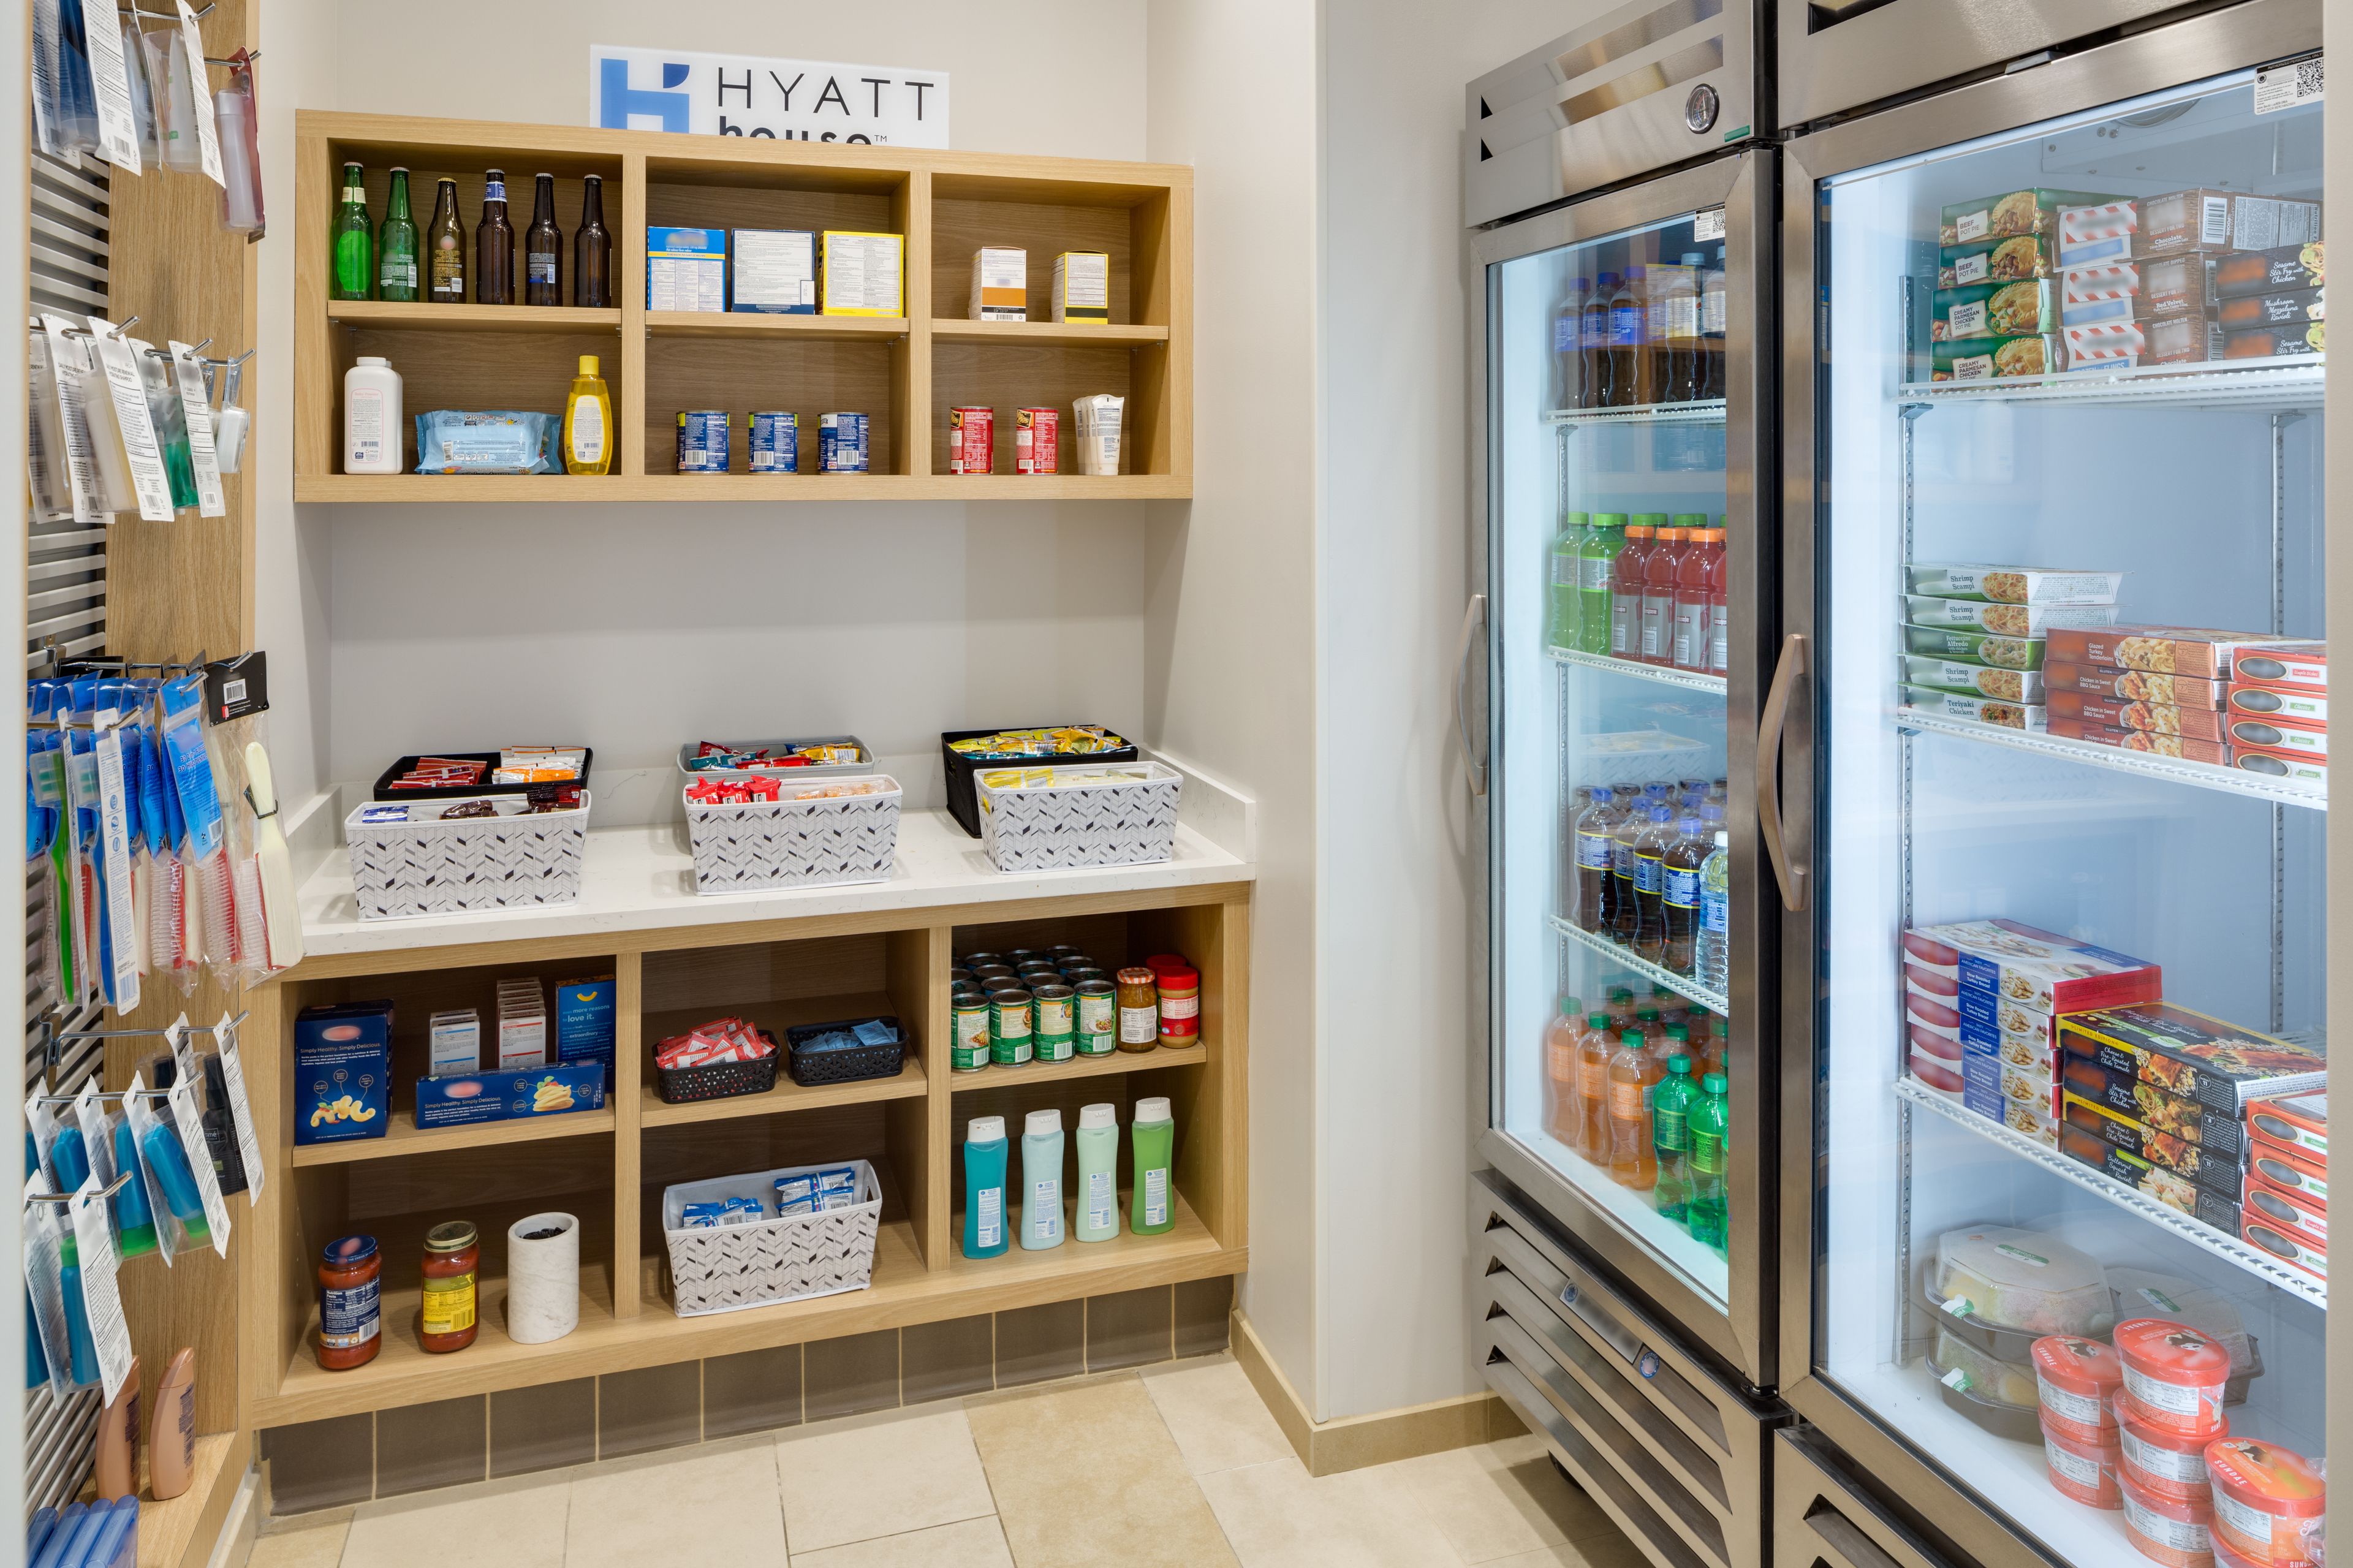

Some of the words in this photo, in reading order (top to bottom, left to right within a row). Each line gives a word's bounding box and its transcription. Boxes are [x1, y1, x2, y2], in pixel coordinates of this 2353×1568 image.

[719, 67, 934, 121] HYATT
[2147, 197, 2167, 206] CHOCOLATE
[1960, 220, 1974, 229] BEEF
[2155, 235, 2181, 244] Chocolate
[1958, 262, 1972, 271] BEEF
[2272, 275, 2296, 284] Chicken
[2265, 298, 2294, 307] Mushroom
[1954, 306, 1972, 316] CREAMY
[1954, 310, 1979, 320] PARMESAN
[2268, 305, 2298, 314] Mezzaluna
[1955, 316, 1974, 325] CHICKEN
[2153, 320, 2173, 328] CHOCOLATE
[1959, 364, 1986, 373] PARMESAN
[1961, 960, 1978, 968] AMERICAN
[1979, 965, 1995, 974] FAVORITES
[1976, 975, 1990, 983] Roasted
[1961, 990, 1977, 1000] AMERICAN
[1978, 997, 1994, 1006] FAVORITES
[1975, 1006, 1988, 1015] Roasted
[1963, 1023, 1979, 1032] AMERICAN
[1980, 1029, 1996, 1039] FAVORITES
[2074, 1026, 2093, 1036] LIMITED
[2096, 1034, 2115, 1045] EDITION
[1977, 1039, 1991, 1048] Roasted
[2104, 1047, 2120, 1056] Cheese
[2101, 1051, 2129, 1067] Fire-Roasted
[2101, 1058, 2113, 1066] Chile
[2113, 1062, 2130, 1073] Tamale
[2112, 1083, 2131, 1096] Sesame
[2110, 1096, 2130, 1108] Chicken
[2081, 1099, 2099, 1110] LIMITED
[2101, 1109, 2121, 1121] EDITION
[2110, 1122, 2126, 1132] Cheese
[2106, 1126, 2135, 1143] Fire-Roasted
[2107, 1133, 2118, 1142] Chile
[2119, 1138, 2134, 1149] Tamale
[2108, 1154, 2131, 1171] Butternut
[2109, 1162, 2128, 1175] Squash
[2115, 1172, 2132, 1184] Ravioli
[2123, 1320, 2153, 1331] SUNDAE
[2037, 1347, 2056, 1366] SUNDAE
[2215, 1460, 2248, 1485] SUNDAE
